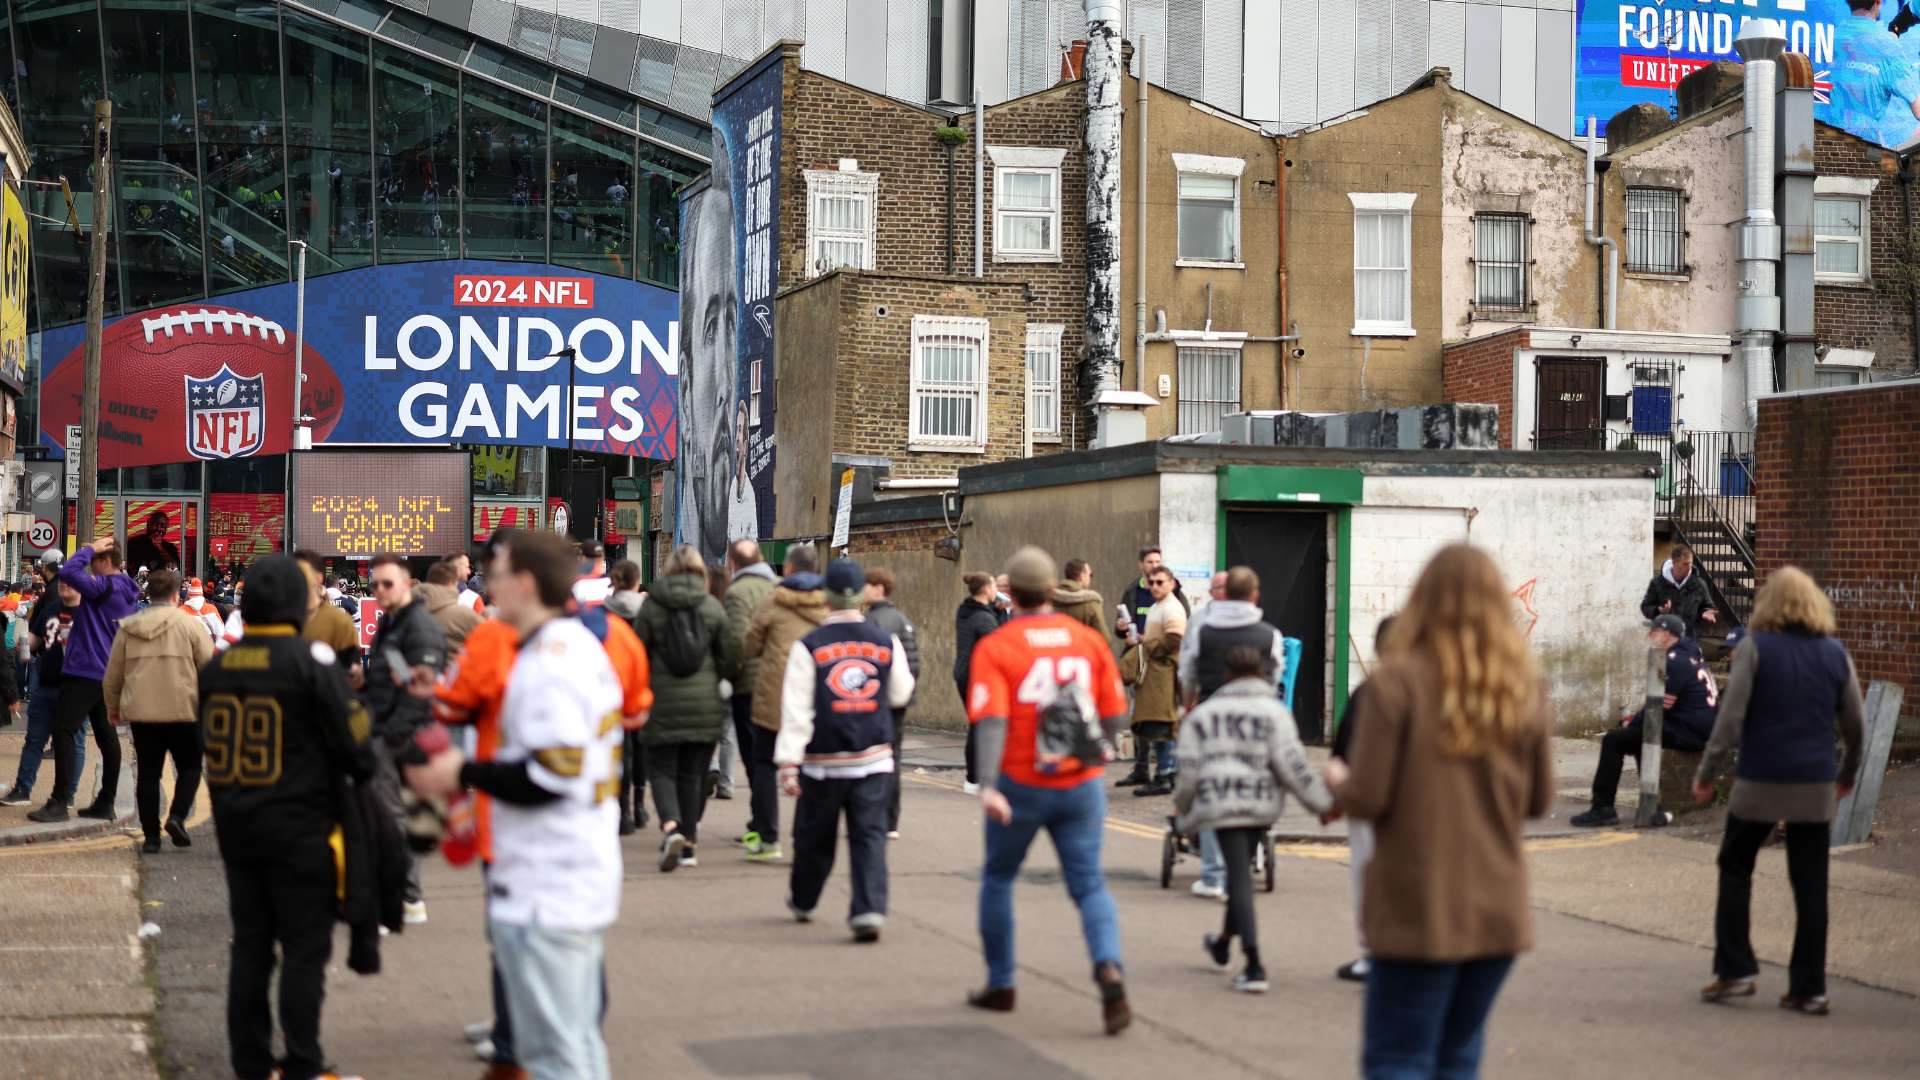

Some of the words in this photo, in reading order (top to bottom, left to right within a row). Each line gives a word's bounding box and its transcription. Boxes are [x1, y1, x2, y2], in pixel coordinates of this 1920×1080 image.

[1619, 5, 1834, 64] FOUNDION
[745, 187, 756, 235] OF
[756, 178, 771, 230] OUR
[744, 227, 771, 305] OWN
[459, 280, 528, 303] 2024
[534, 281, 588, 304] NFL
[364, 315, 679, 375] LONDON
[196, 411, 257, 455] NFL
[398, 382, 644, 442] GAMES
[312, 496, 379, 512] 2024
[399, 496, 451, 512] NFL
[326, 515, 434, 532] LONDON
[32, 529, 53, 541] 20
[336, 535, 424, 552] GAMES
[203, 692, 284, 786] 99
